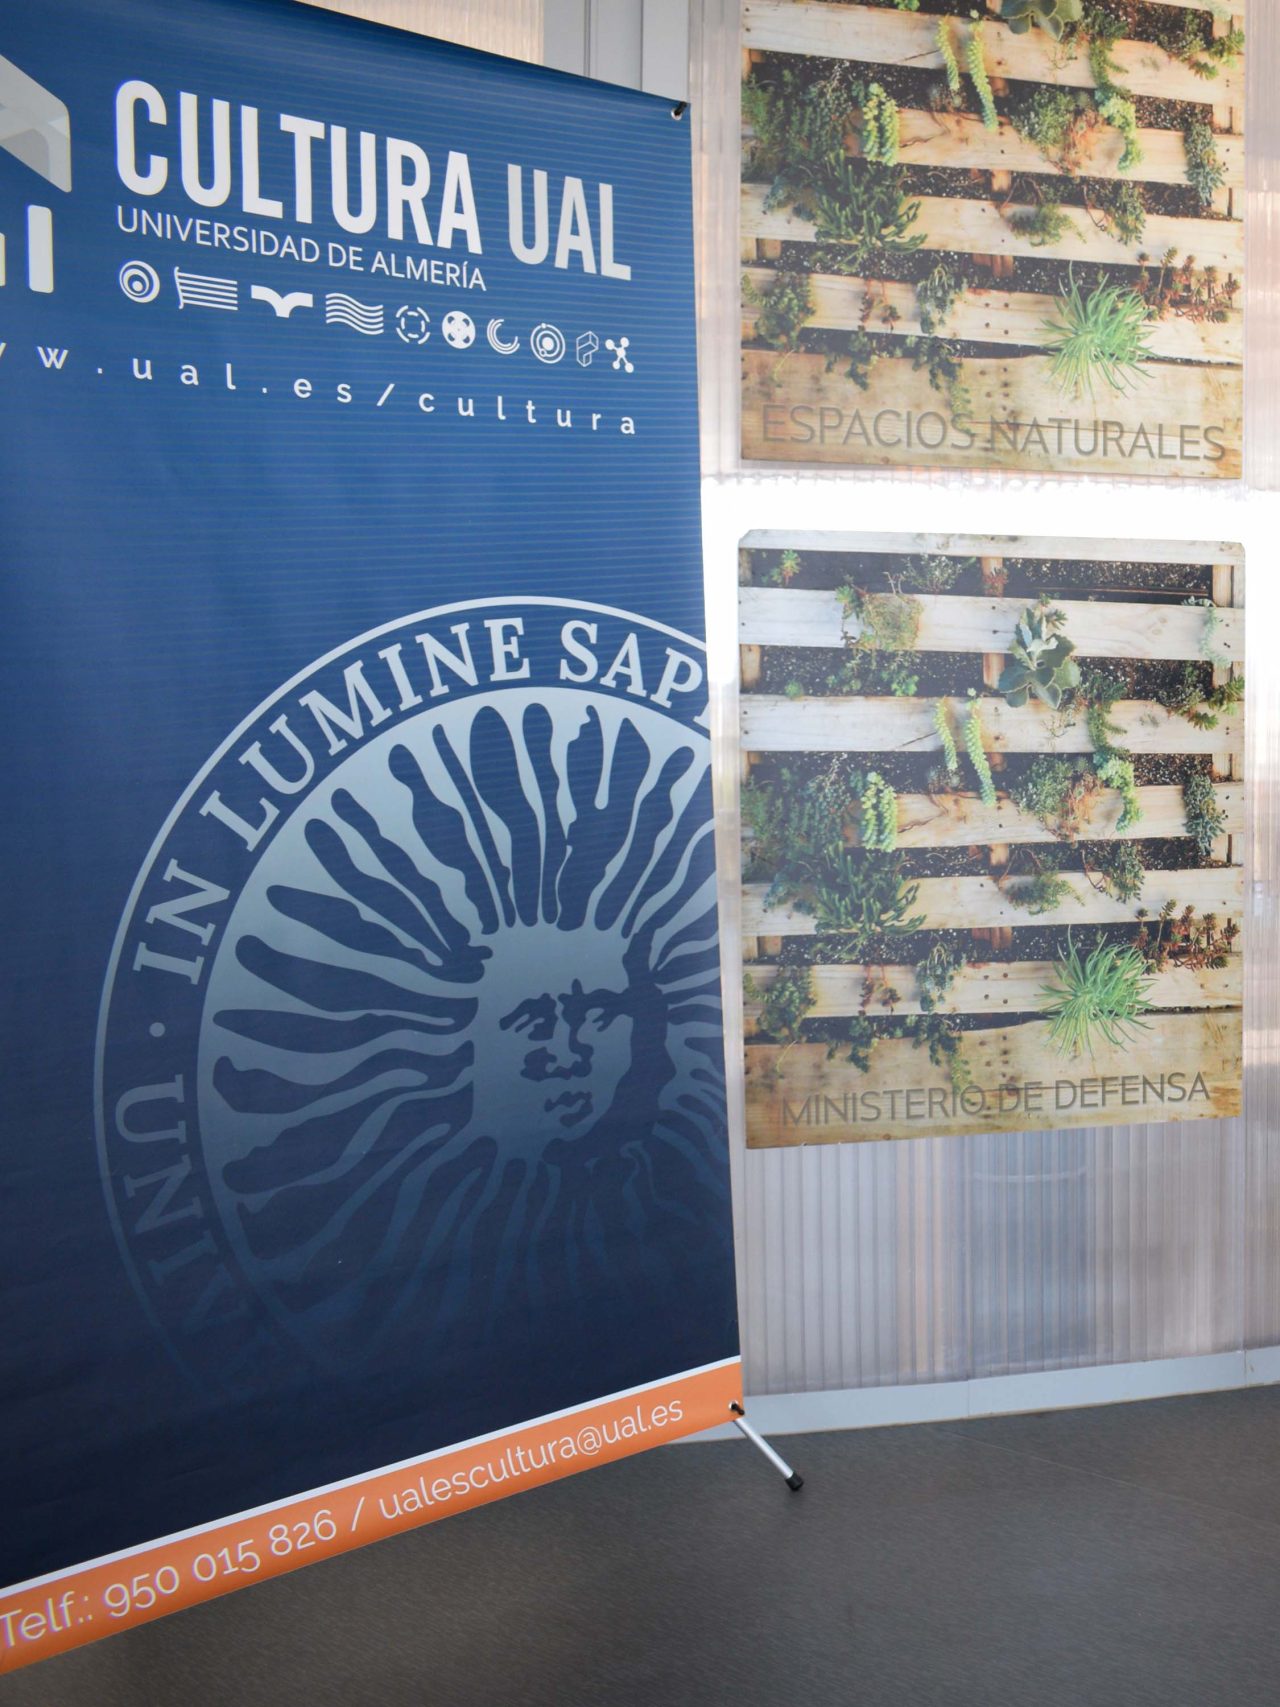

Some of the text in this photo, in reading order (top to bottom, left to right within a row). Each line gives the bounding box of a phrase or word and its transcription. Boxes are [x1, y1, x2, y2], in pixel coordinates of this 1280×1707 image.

[115, 79, 632, 281] CULTURA UAL
[117, 205, 487, 291] UNIVERSIDAD DE ALMERÍA
[0, 342, 636, 436] w.ual.es/cultura
[762, 404, 1226, 462] ESPACIOS NATURALES
[133, 860, 231, 986] IN
[199, 617, 531, 852] LUMINE
[782, 1072, 1211, 1127] MINISTERIO DE DEFENSA
[0, 1396, 684, 1648] Telf.: 950 015 826 / ualescultura@ual.es
